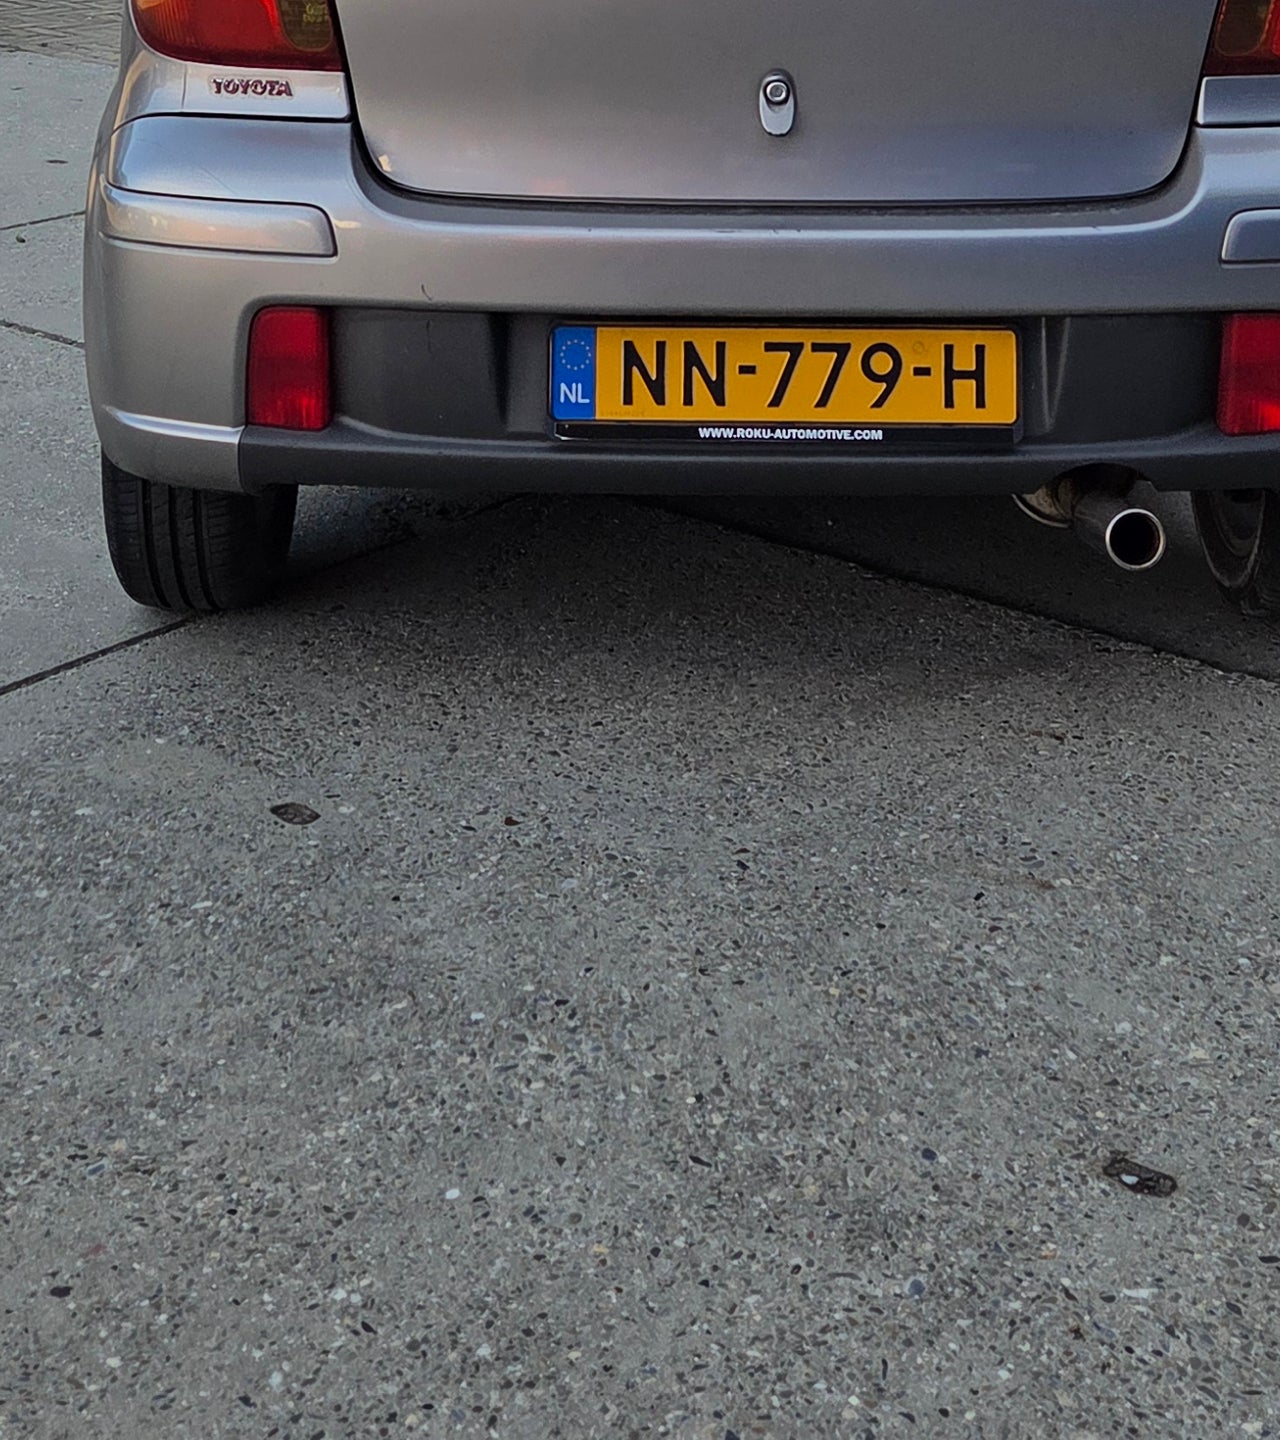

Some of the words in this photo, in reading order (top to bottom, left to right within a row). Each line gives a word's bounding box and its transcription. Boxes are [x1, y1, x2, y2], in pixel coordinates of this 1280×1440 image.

[212, 78, 293, 97] TOYOTA
[622, 340, 987, 409] NN-779-H
[559, 383, 590, 404] NL
[698, 427, 883, 441] WWW.ROKU-AUTOMOTIVE.COM
